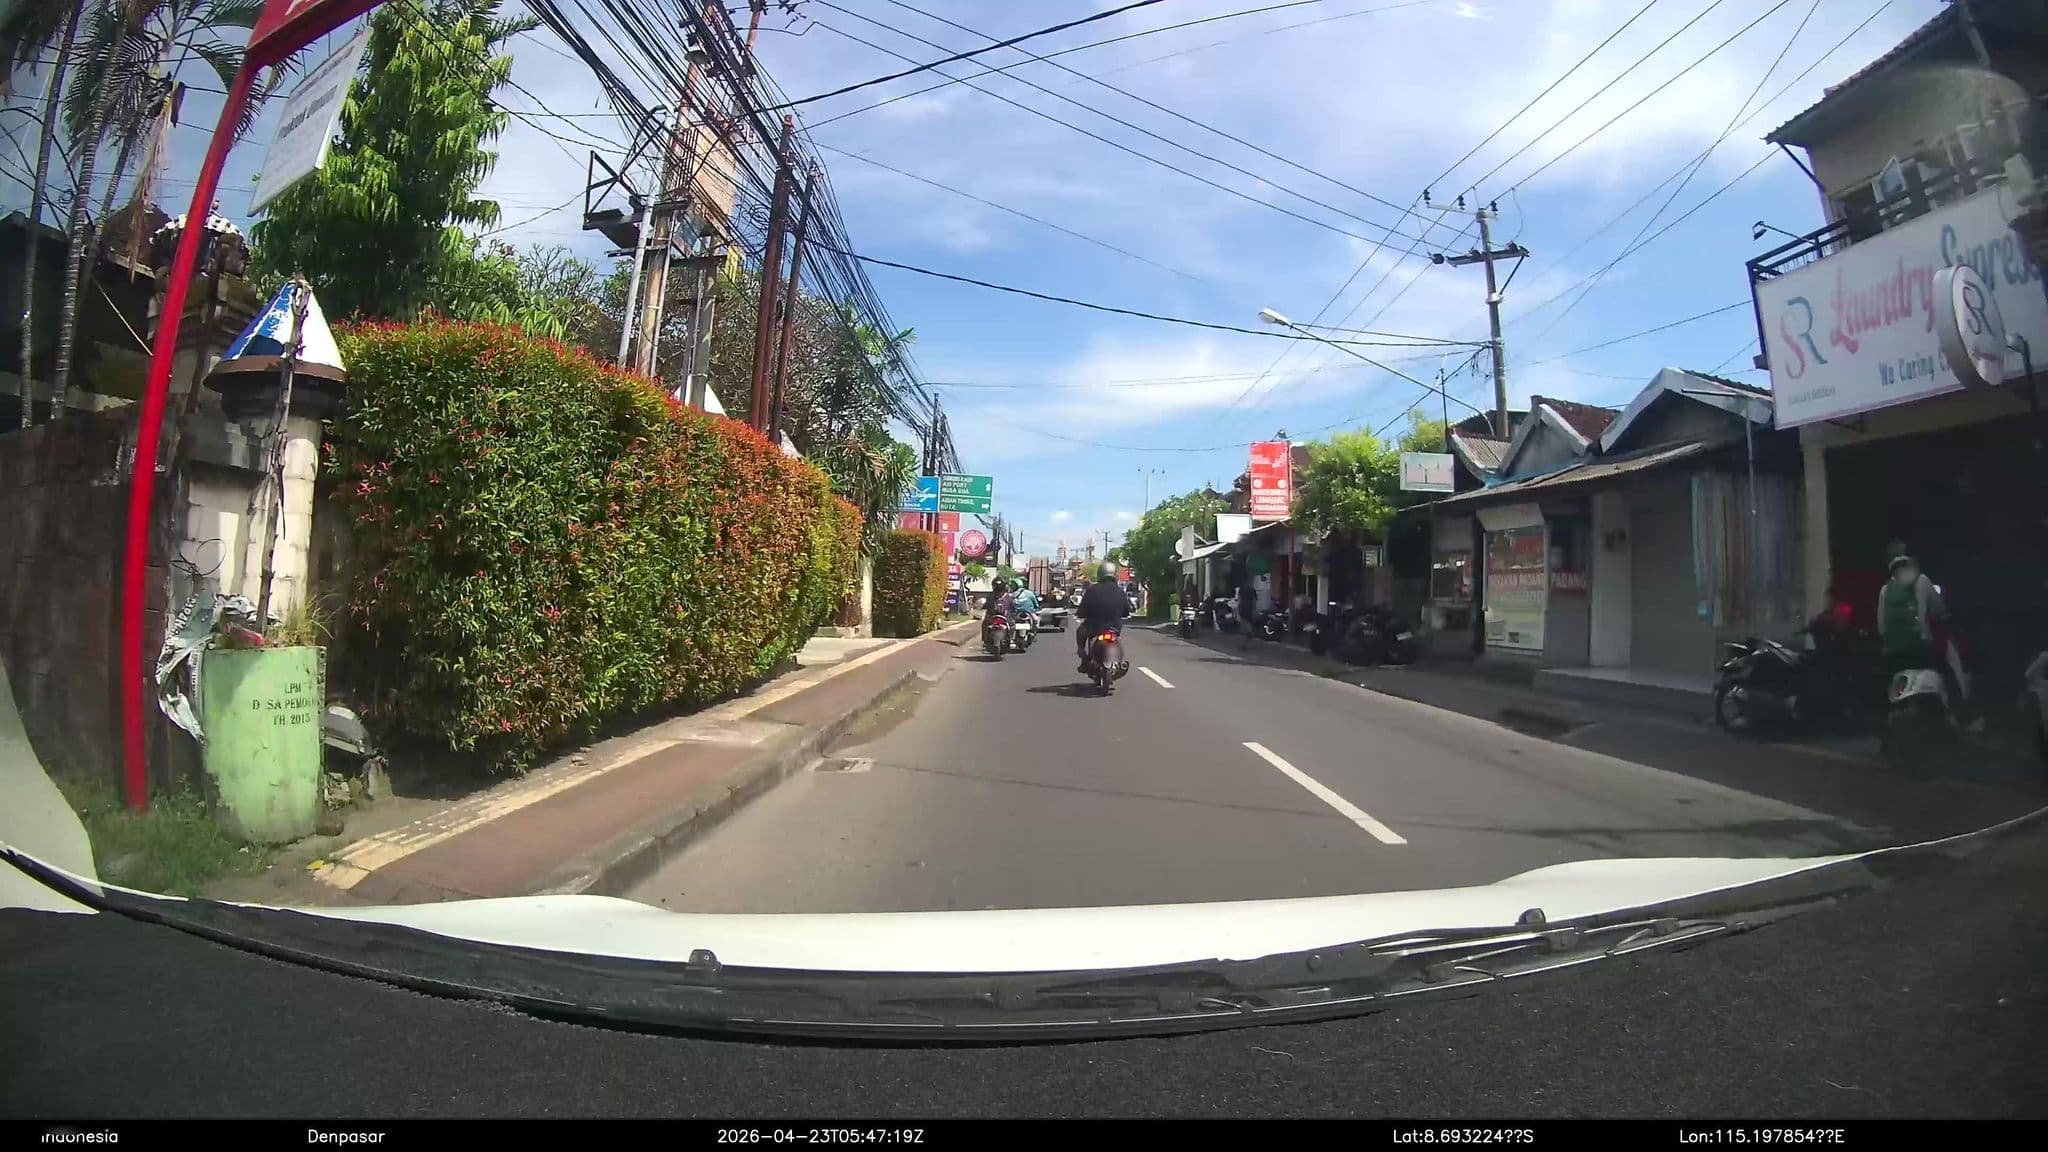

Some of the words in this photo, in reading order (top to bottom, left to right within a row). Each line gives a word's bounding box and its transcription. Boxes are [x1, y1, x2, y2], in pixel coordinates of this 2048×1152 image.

[1830, 256, 1935, 354] Laundry
[1879, 360, 1894, 386] We
[252, 699, 282, 710] DSA
